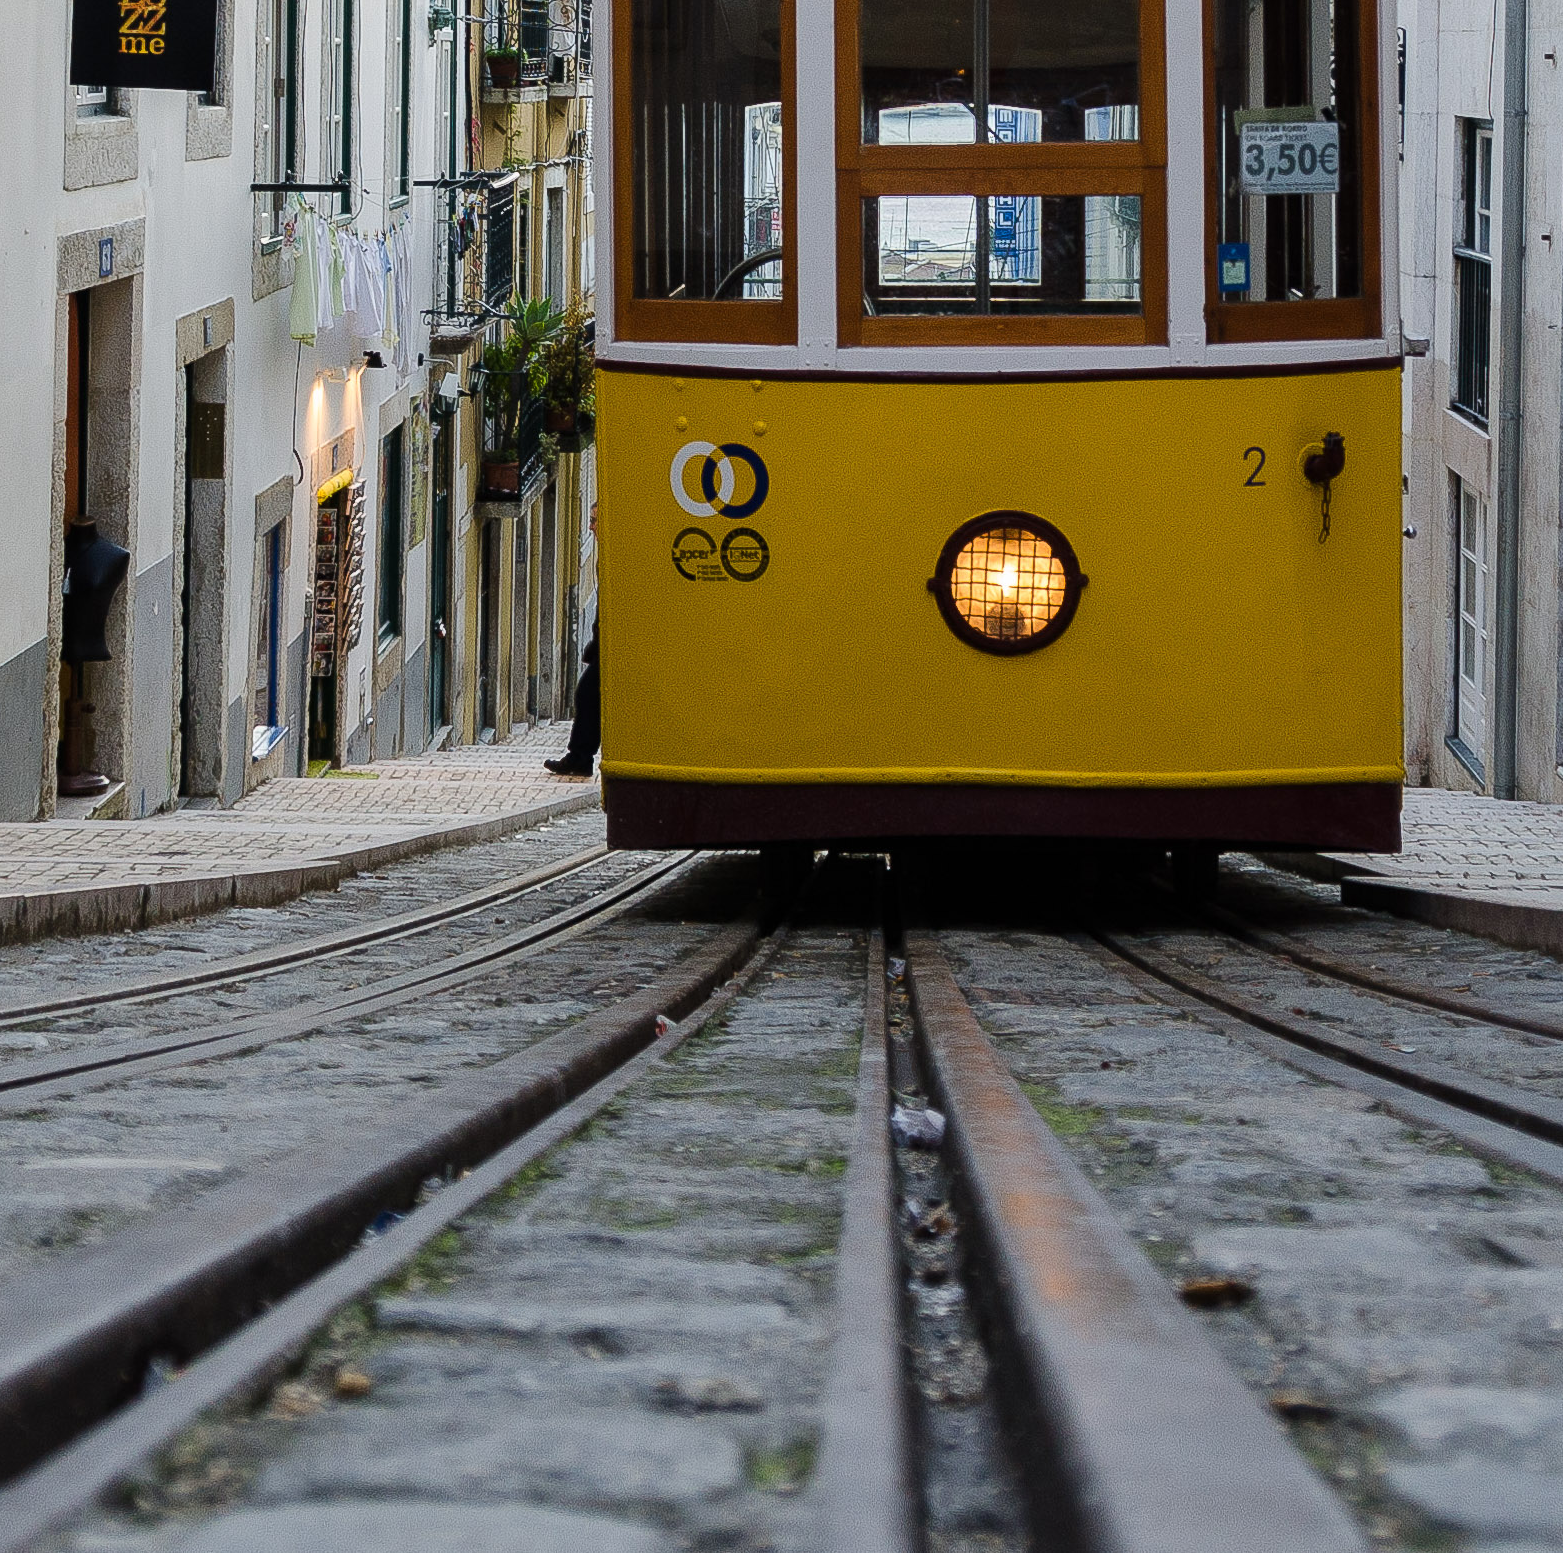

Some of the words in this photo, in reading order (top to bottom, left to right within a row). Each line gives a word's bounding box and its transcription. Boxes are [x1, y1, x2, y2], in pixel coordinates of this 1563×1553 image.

[118, 36, 165, 55] me
[1245, 143, 1337, 181] 3,50€
[1244, 446, 1266, 487] 2
[679, 549, 709, 563] apcer
